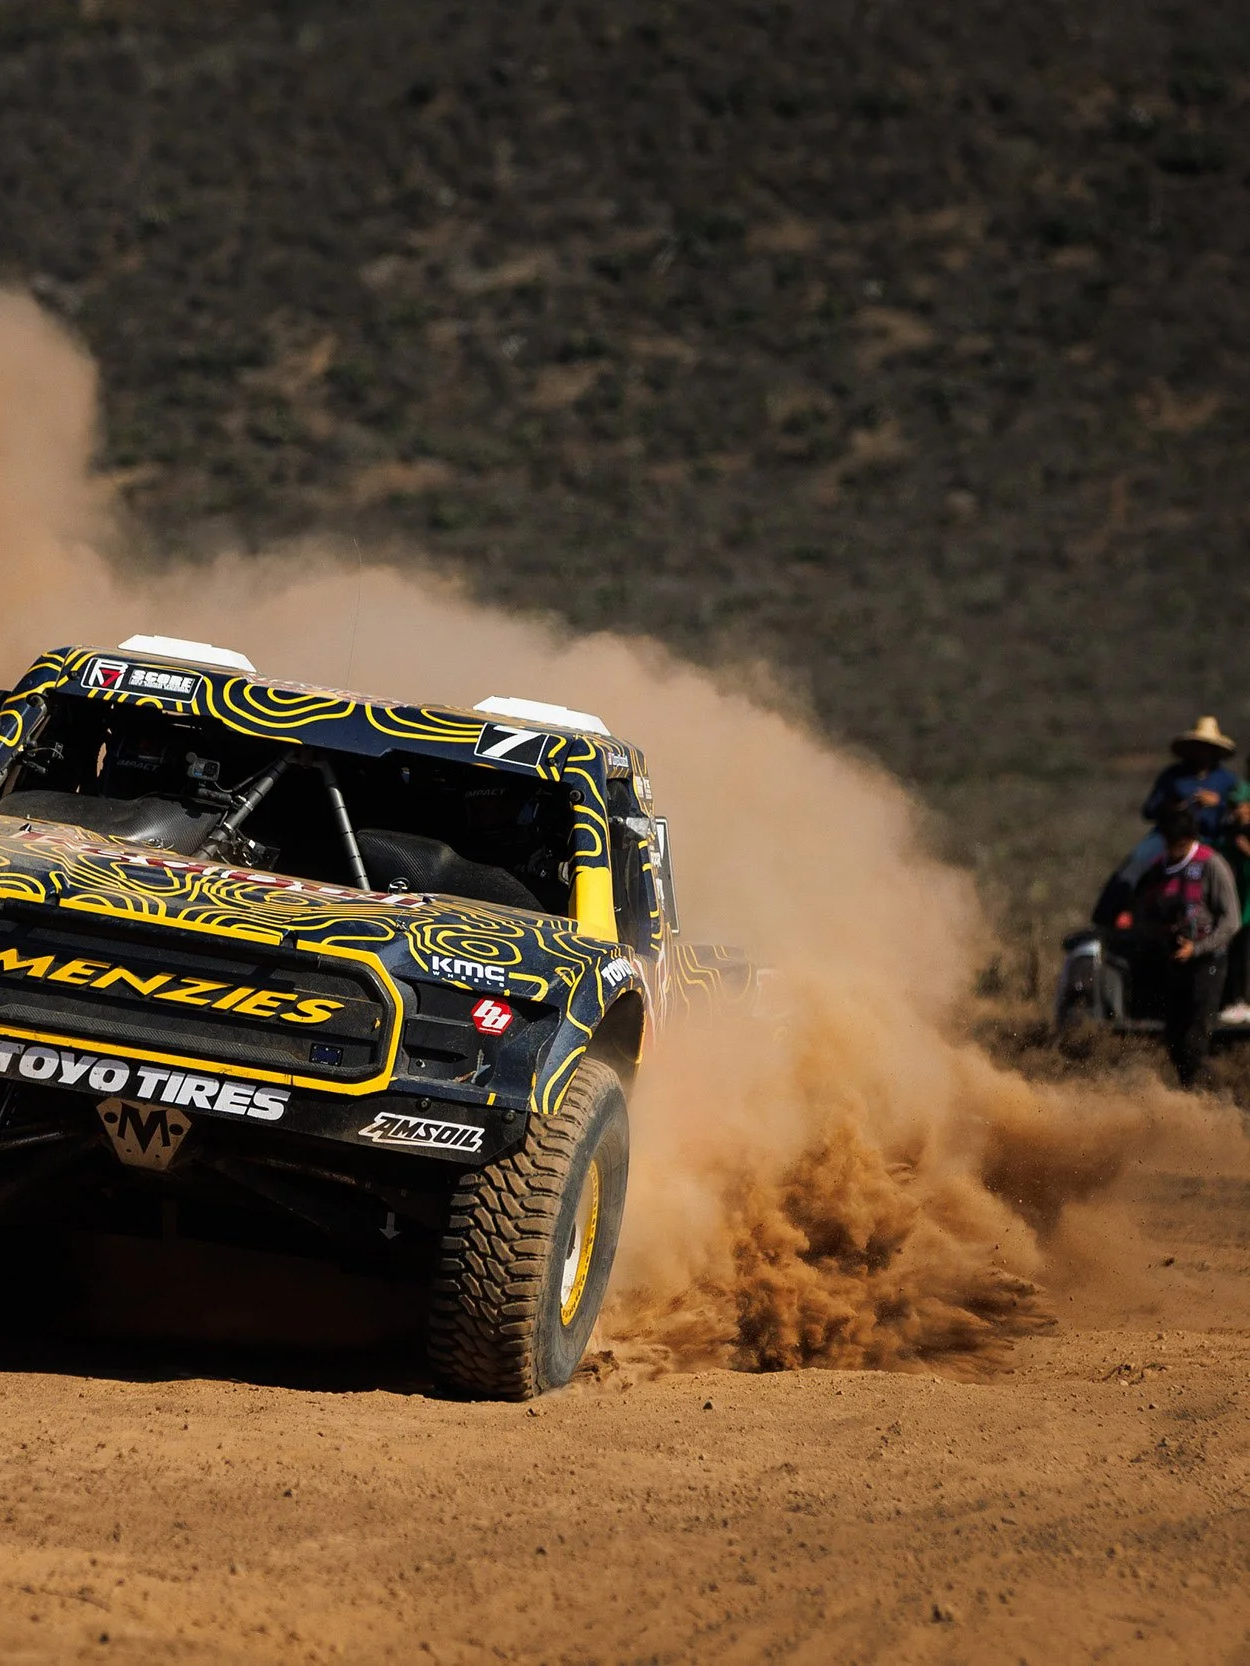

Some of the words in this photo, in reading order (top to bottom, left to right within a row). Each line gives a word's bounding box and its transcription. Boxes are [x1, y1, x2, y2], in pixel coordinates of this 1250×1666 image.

[132, 668, 193, 689] SCORE
[482, 724, 541, 758] 7
[464, 786, 507, 798] IMPACT
[600, 957, 636, 988] TOYO
[136, 1067, 292, 1121] TIRES
[116, 1102, 171, 1155] M
[359, 1112, 485, 1152] AMSOIL
